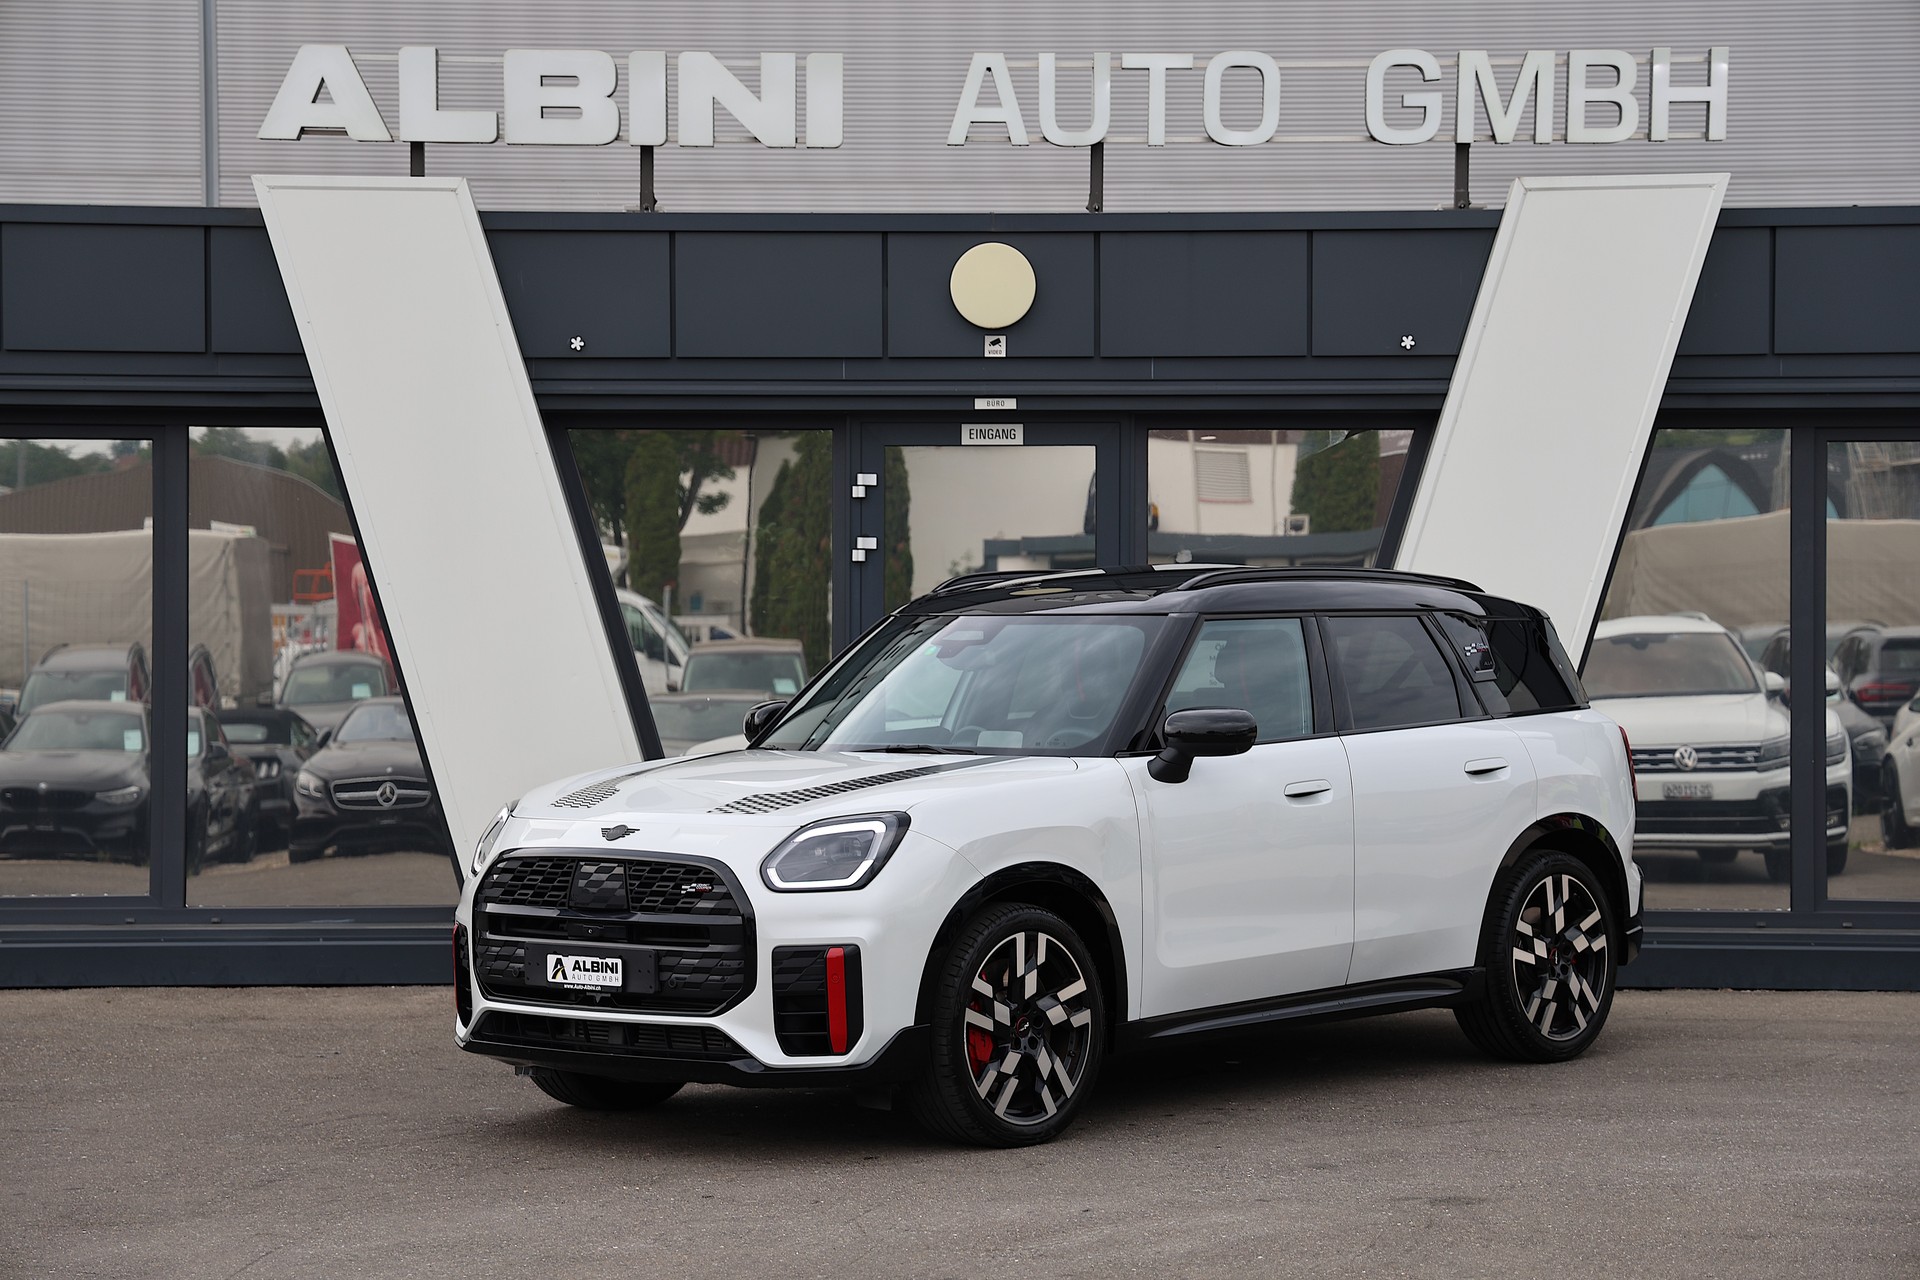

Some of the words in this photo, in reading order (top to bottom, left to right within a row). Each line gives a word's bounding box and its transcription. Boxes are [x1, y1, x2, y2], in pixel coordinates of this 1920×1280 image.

[257, 44, 844, 149] ALBINI
[947, 50, 1281, 147] AUTO
[1365, 46, 1730, 146] GMBH
[986, 399, 1005, 407] BÜRO
[969, 428, 1017, 440] EINGANG
[572, 959, 619, 974] ALBINI
[571, 973, 593, 981] AUTO
[596, 974, 620, 983] GMBH
